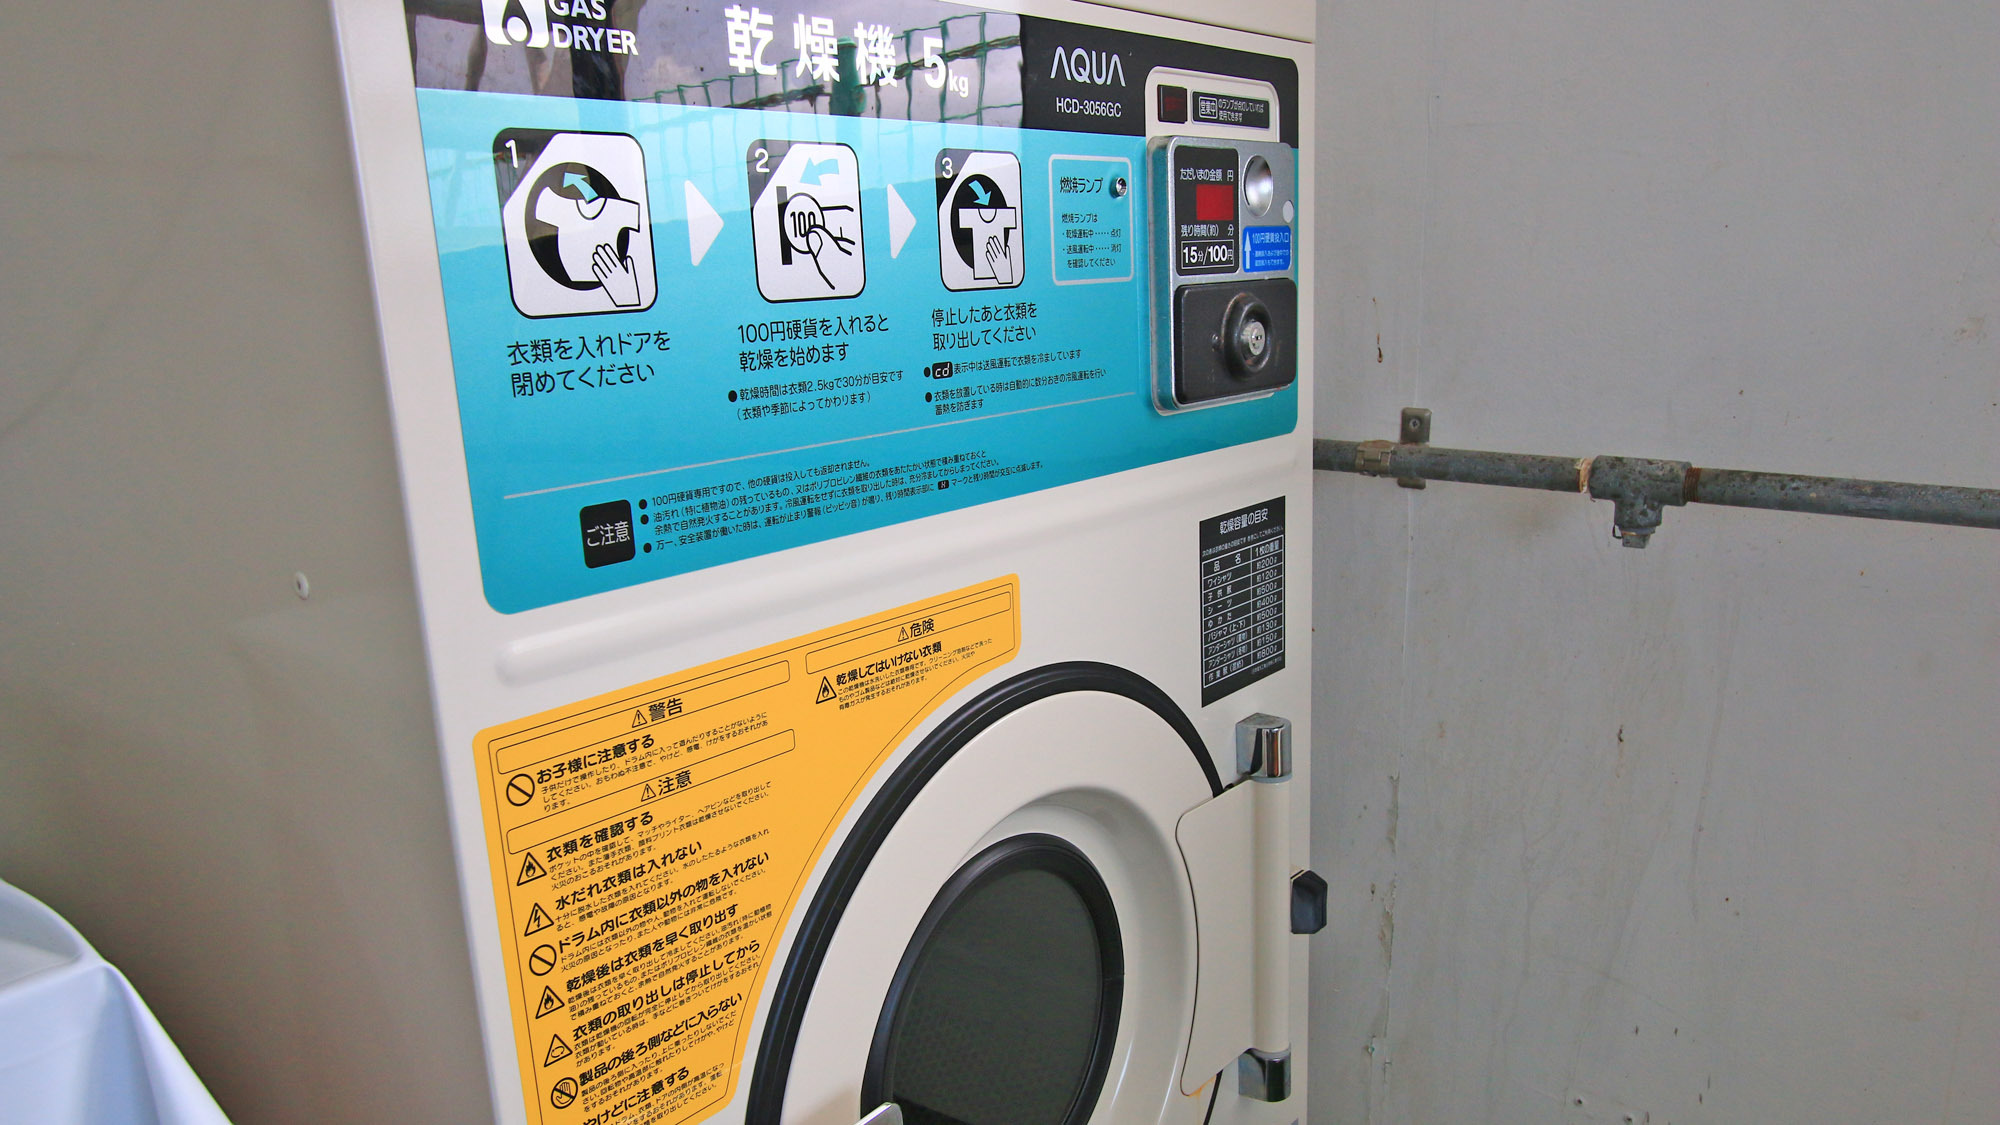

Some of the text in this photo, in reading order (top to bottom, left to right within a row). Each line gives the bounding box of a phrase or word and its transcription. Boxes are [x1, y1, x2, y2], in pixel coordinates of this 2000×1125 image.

[548, 0, 607, 20] GAS
[551, 22, 638, 56] DRYER
[923, 36, 969, 98] 5kg
[1050, 45, 1126, 87] AQUA
[1055, 96, 1122, 118] HCD-3056GC
[504, 139, 520, 169] 1
[753, 148, 770, 174] 2
[941, 156, 954, 180] 3
[1059, 177, 1104, 194] 燃焼ランプ
[1180, 168, 1223, 182] ただいまの金額
[1061, 212, 1098, 224] 燃焼ランプは
[1066, 257, 1116, 269] を確認してください
[738, 313, 890, 344] 100円硬貨を入れると
[931, 302, 1038, 329] 停止したあと衣類を
[507, 330, 671, 367] 衣類を入れドアを
[932, 325, 1037, 351] 取り出してください
[738, 342, 850, 373] 乾燥を始めます
[511, 363, 656, 398] 閉めてください
[586, 520, 632, 548] ご注意
[1219, 508, 1269, 535] 乾燥容量の目安
[909, 618, 935, 638] 危険
[836, 641, 943, 687] 乾燥してはいけない衣類
[648, 697, 683, 724] 警告
[536, 734, 655, 785] お子様に注意する
[657, 770, 692, 797] 注意
[546, 811, 654, 863] 衣類を確認する
[555, 841, 702, 911] 水だれ衣類は入れない
[559, 851, 769, 954] ドラム内に衣類以外の物を入れない
[566, 903, 739, 993] 乾燥後は衣類を早く取り出す
[572, 939, 760, 1042] 衣類の取り出しは停止してから
[579, 992, 743, 1087] 製品の後ろ側などに入らない
